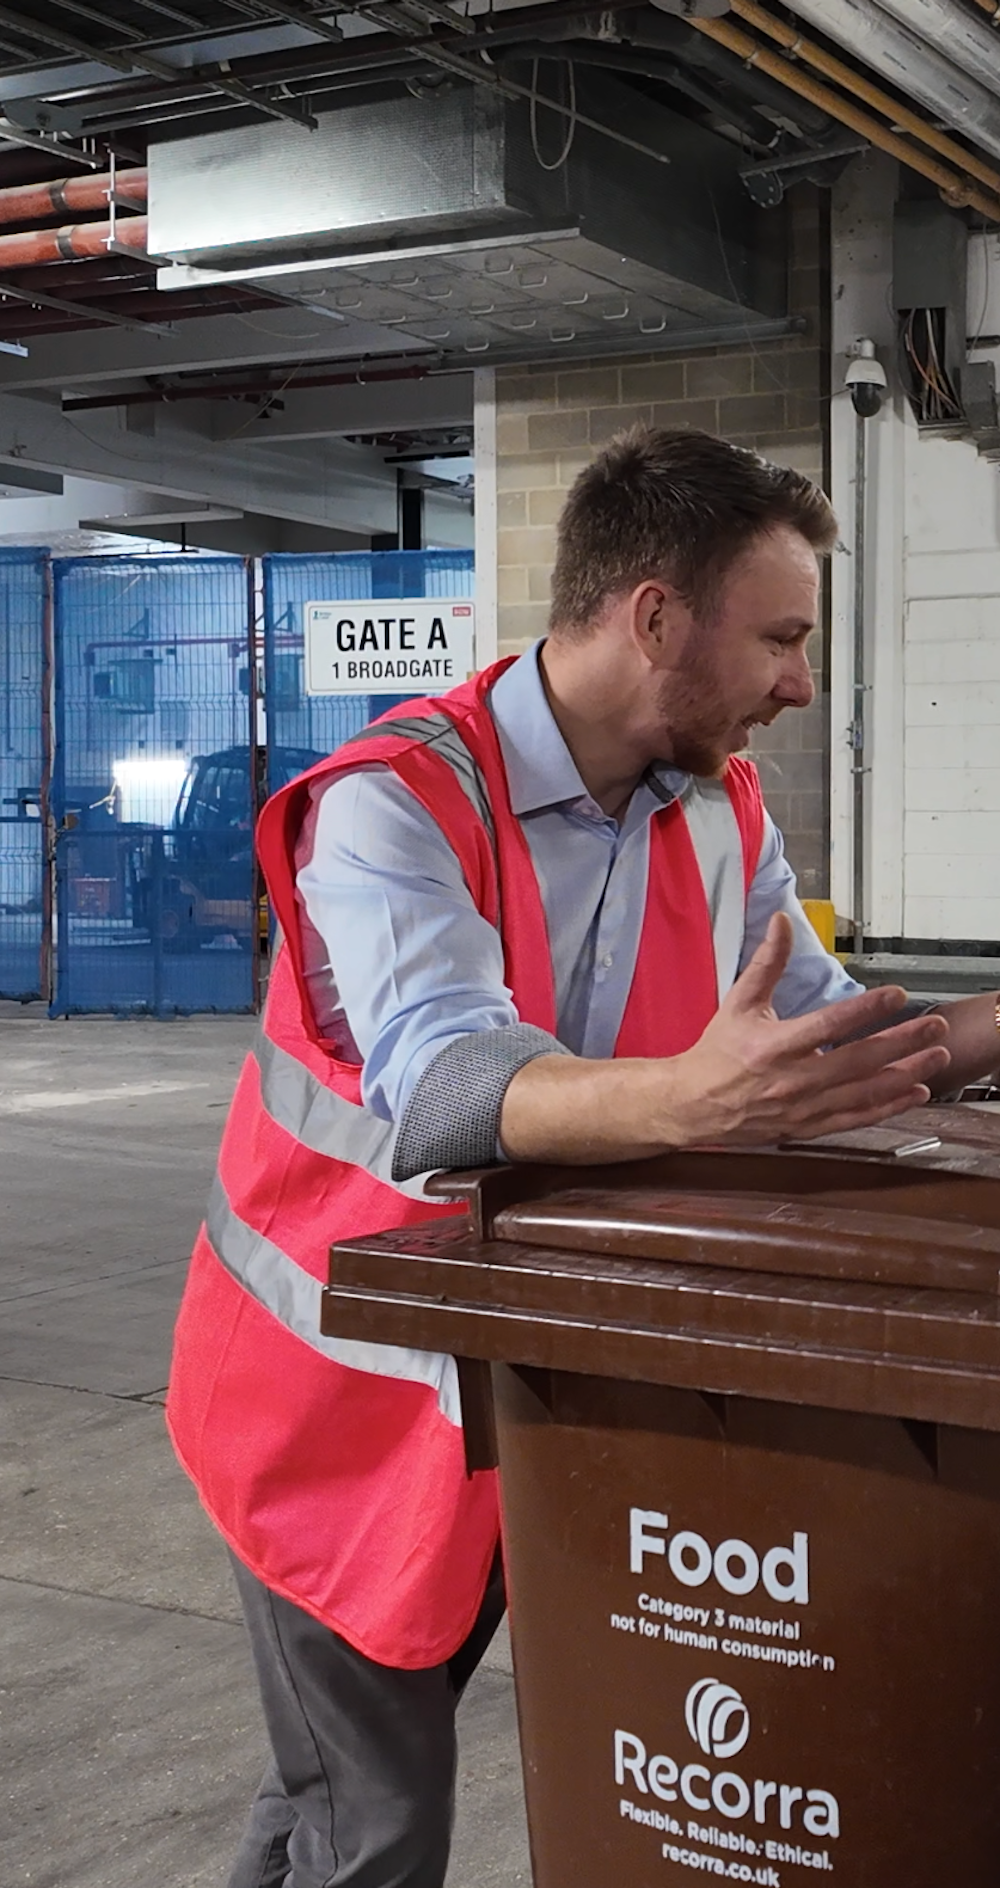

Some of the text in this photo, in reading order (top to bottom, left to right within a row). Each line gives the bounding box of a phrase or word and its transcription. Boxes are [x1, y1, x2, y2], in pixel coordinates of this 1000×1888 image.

[336, 617, 448, 652] GATE A
[332, 659, 454, 680] 1 BROADGATE
[629, 1507, 810, 1606] Food
[610, 1612, 636, 1633] not
[638, 1617, 661, 1638] for
[664, 1622, 718, 1652] human
[637, 1592, 801, 1641] Category 3 material
[614, 1728, 840, 1839] Recorra
[619, 1799, 834, 1872] Flexible. Reliable. Ethical.
[661, 1843, 781, 1888] recorra.co.uk
